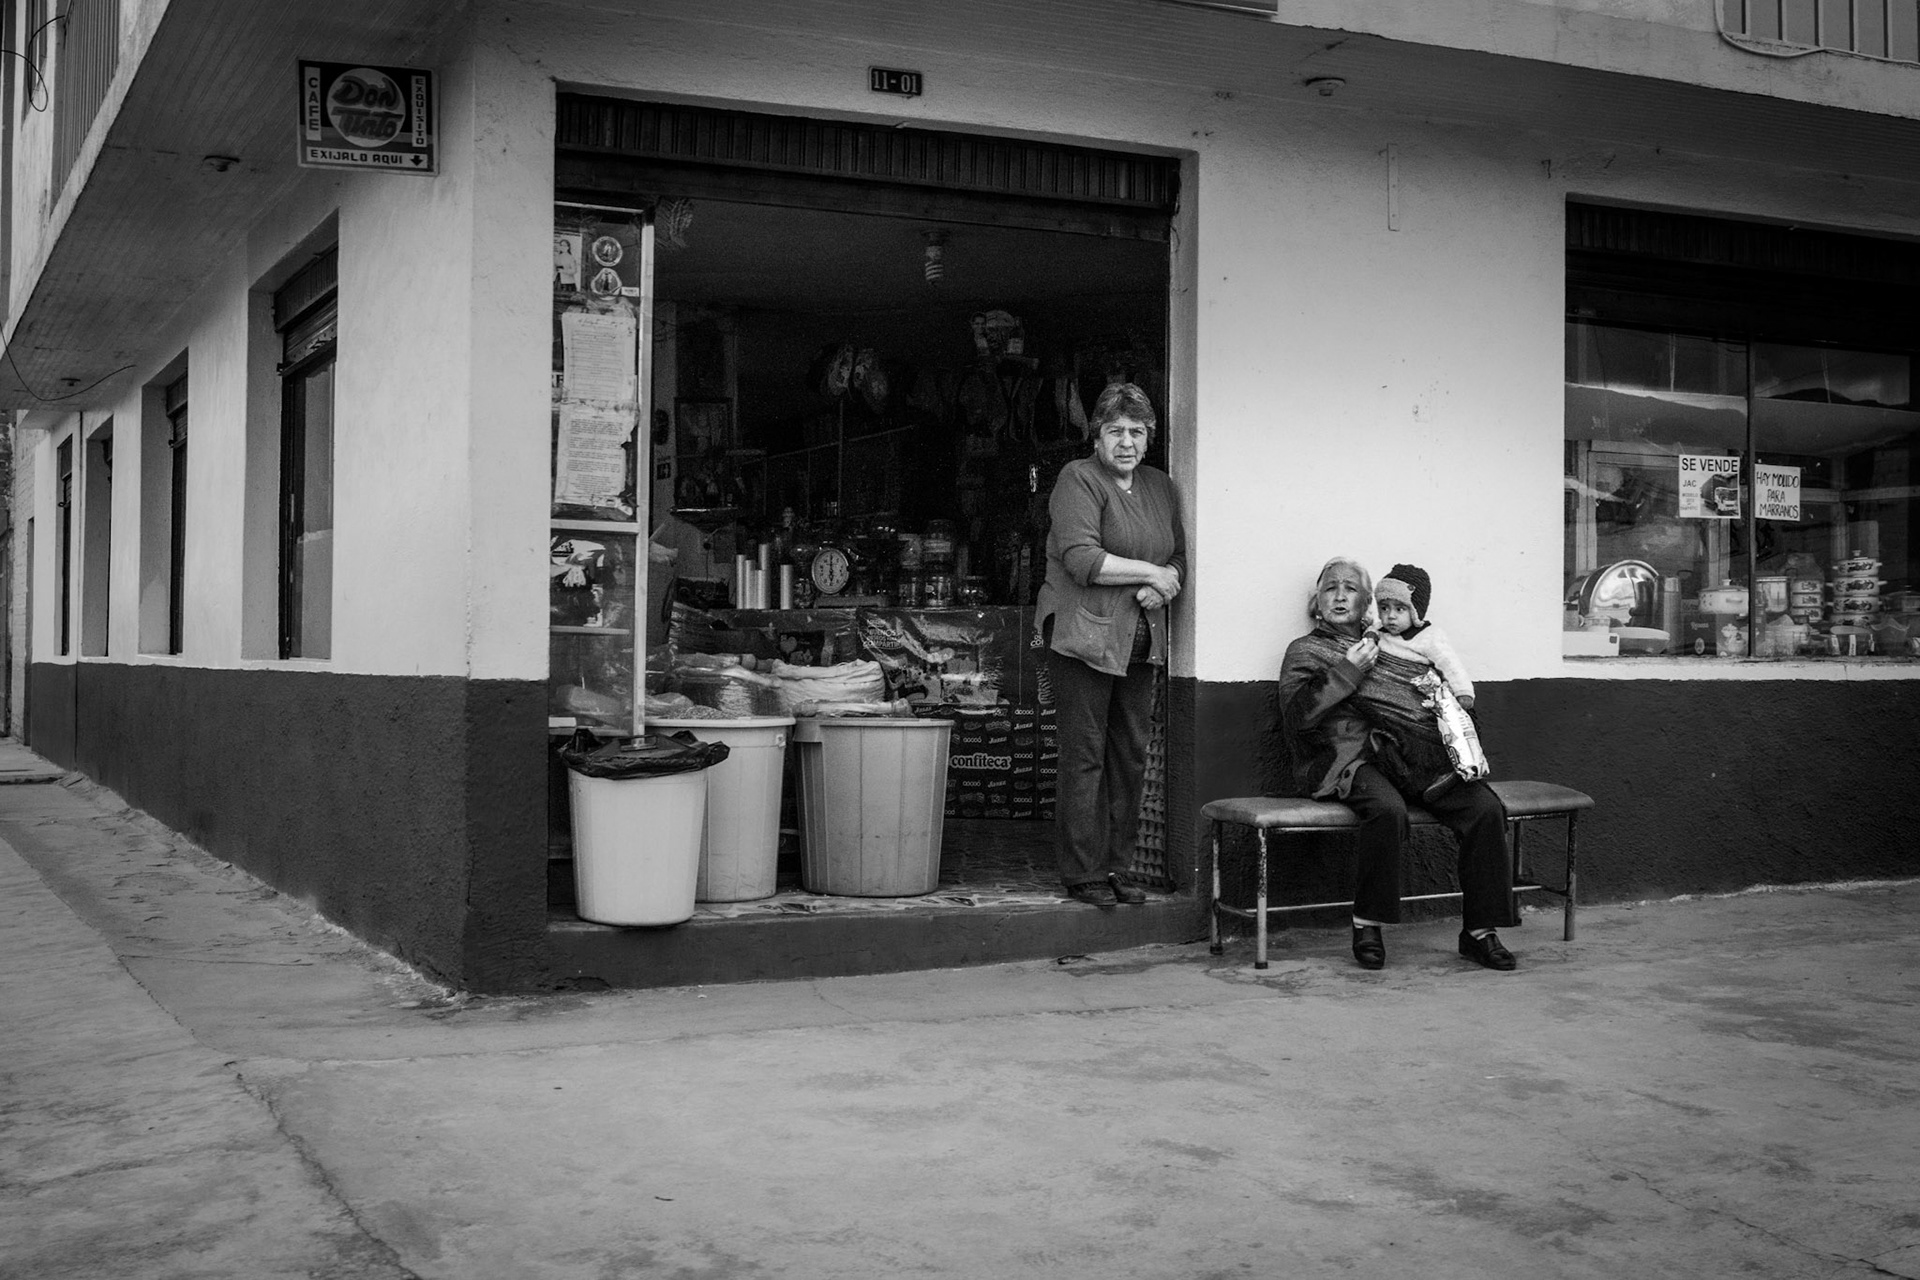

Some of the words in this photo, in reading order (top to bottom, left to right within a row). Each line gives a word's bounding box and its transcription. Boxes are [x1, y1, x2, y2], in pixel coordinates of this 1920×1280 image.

[873, 71, 917, 93] 11-01
[332, 75, 400, 111] Don
[308, 77, 320, 131] CAFE
[415, 78, 425, 145] EXQUISITO
[310, 149, 368, 163] EXIJALO
[372, 154, 403, 164] AQUI
[1681, 457, 1697, 471] SE
[1699, 458, 1739, 472] VENDE
[1682, 479, 1697, 488] JAC
[1756, 471, 1770, 486] HAY
[1771, 473, 1800, 488] MOLIDO
[1767, 489, 1786, 503] PARA
[1760, 503, 1799, 519] MARRANOS
[951, 753, 1010, 769] confiteca
